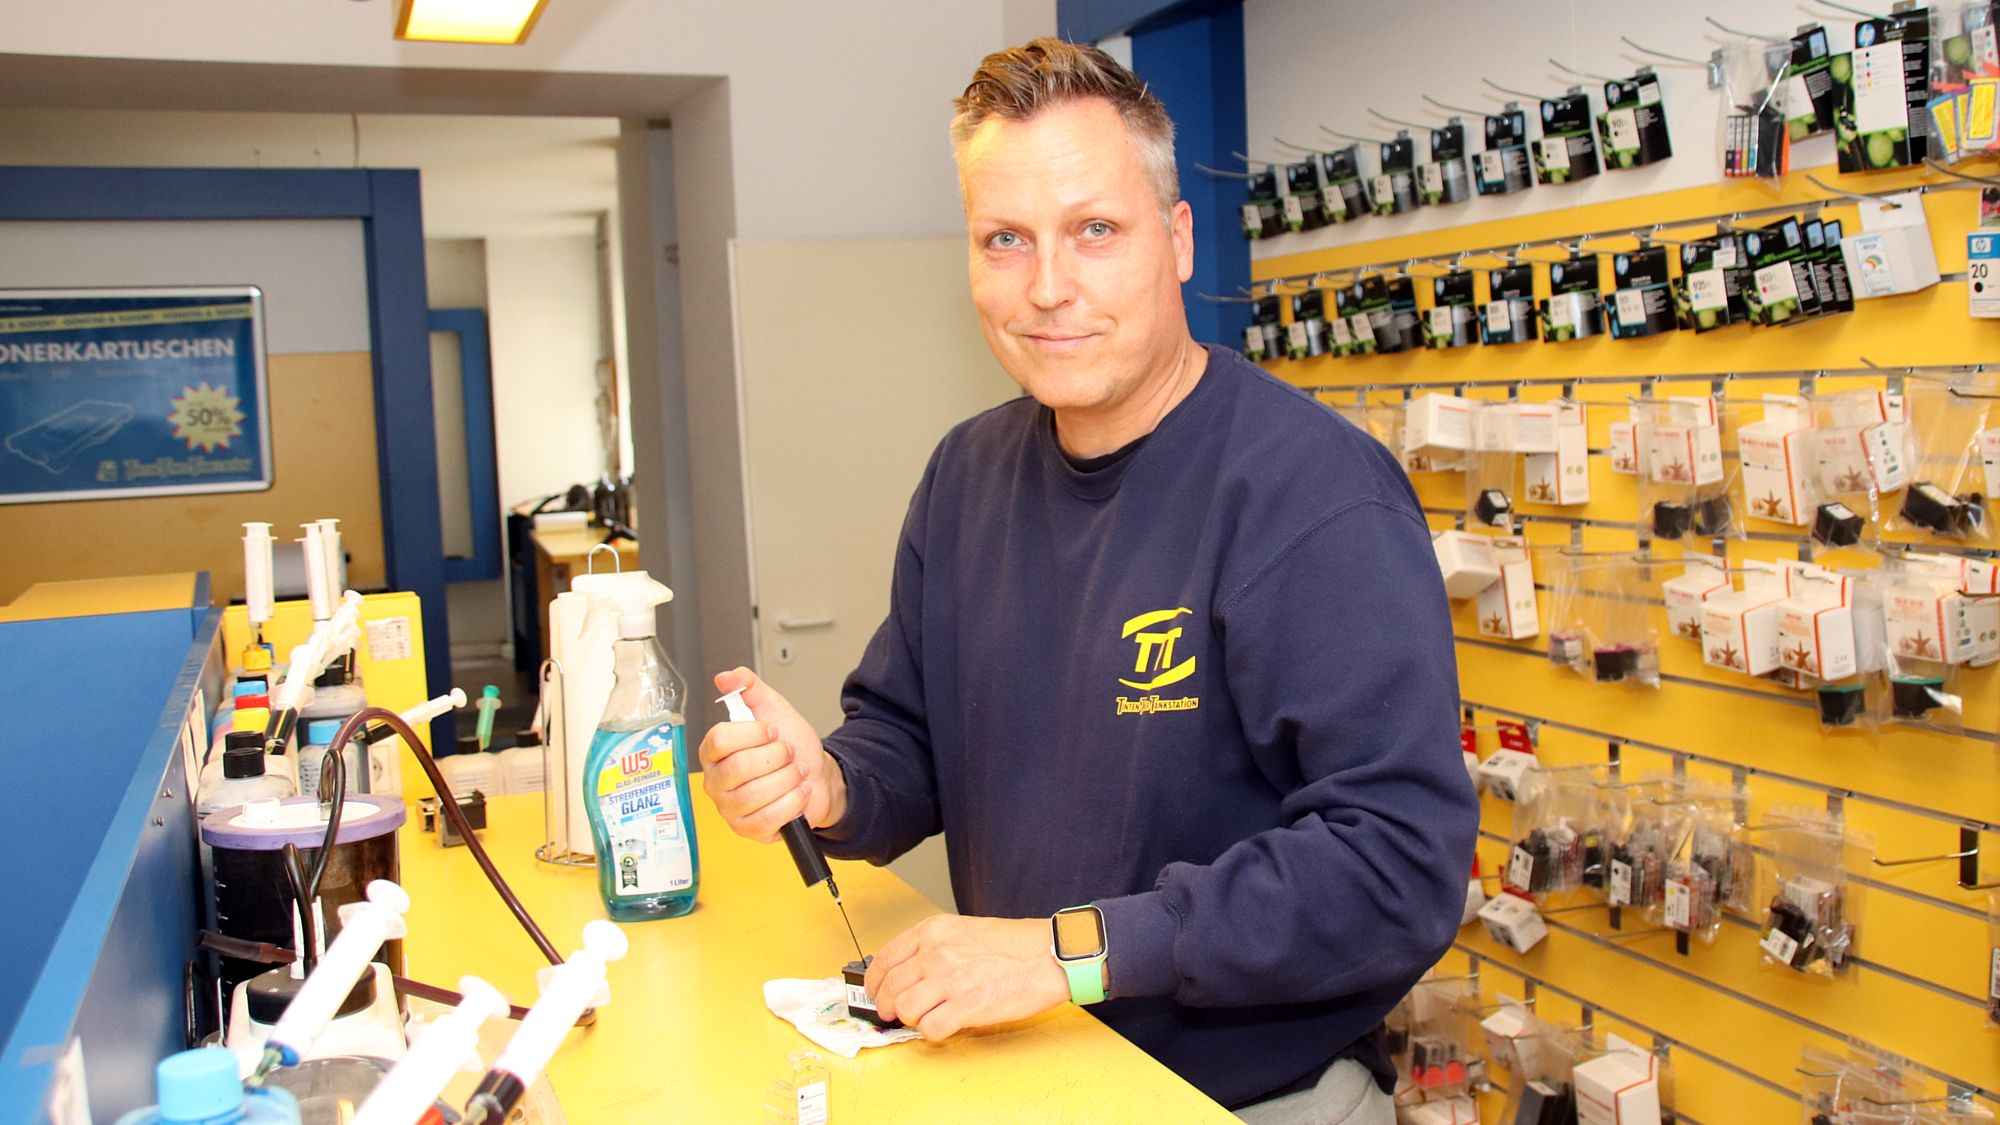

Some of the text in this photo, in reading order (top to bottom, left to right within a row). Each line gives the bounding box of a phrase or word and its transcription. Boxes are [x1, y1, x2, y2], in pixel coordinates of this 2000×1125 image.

[1971, 263, 1988, 279] 20
[186, 407, 232, 426] 50%
[621, 748, 651, 777] W5
[608, 780, 671, 805] STREIFENFREIER
[621, 793, 661, 816] GLANZ
